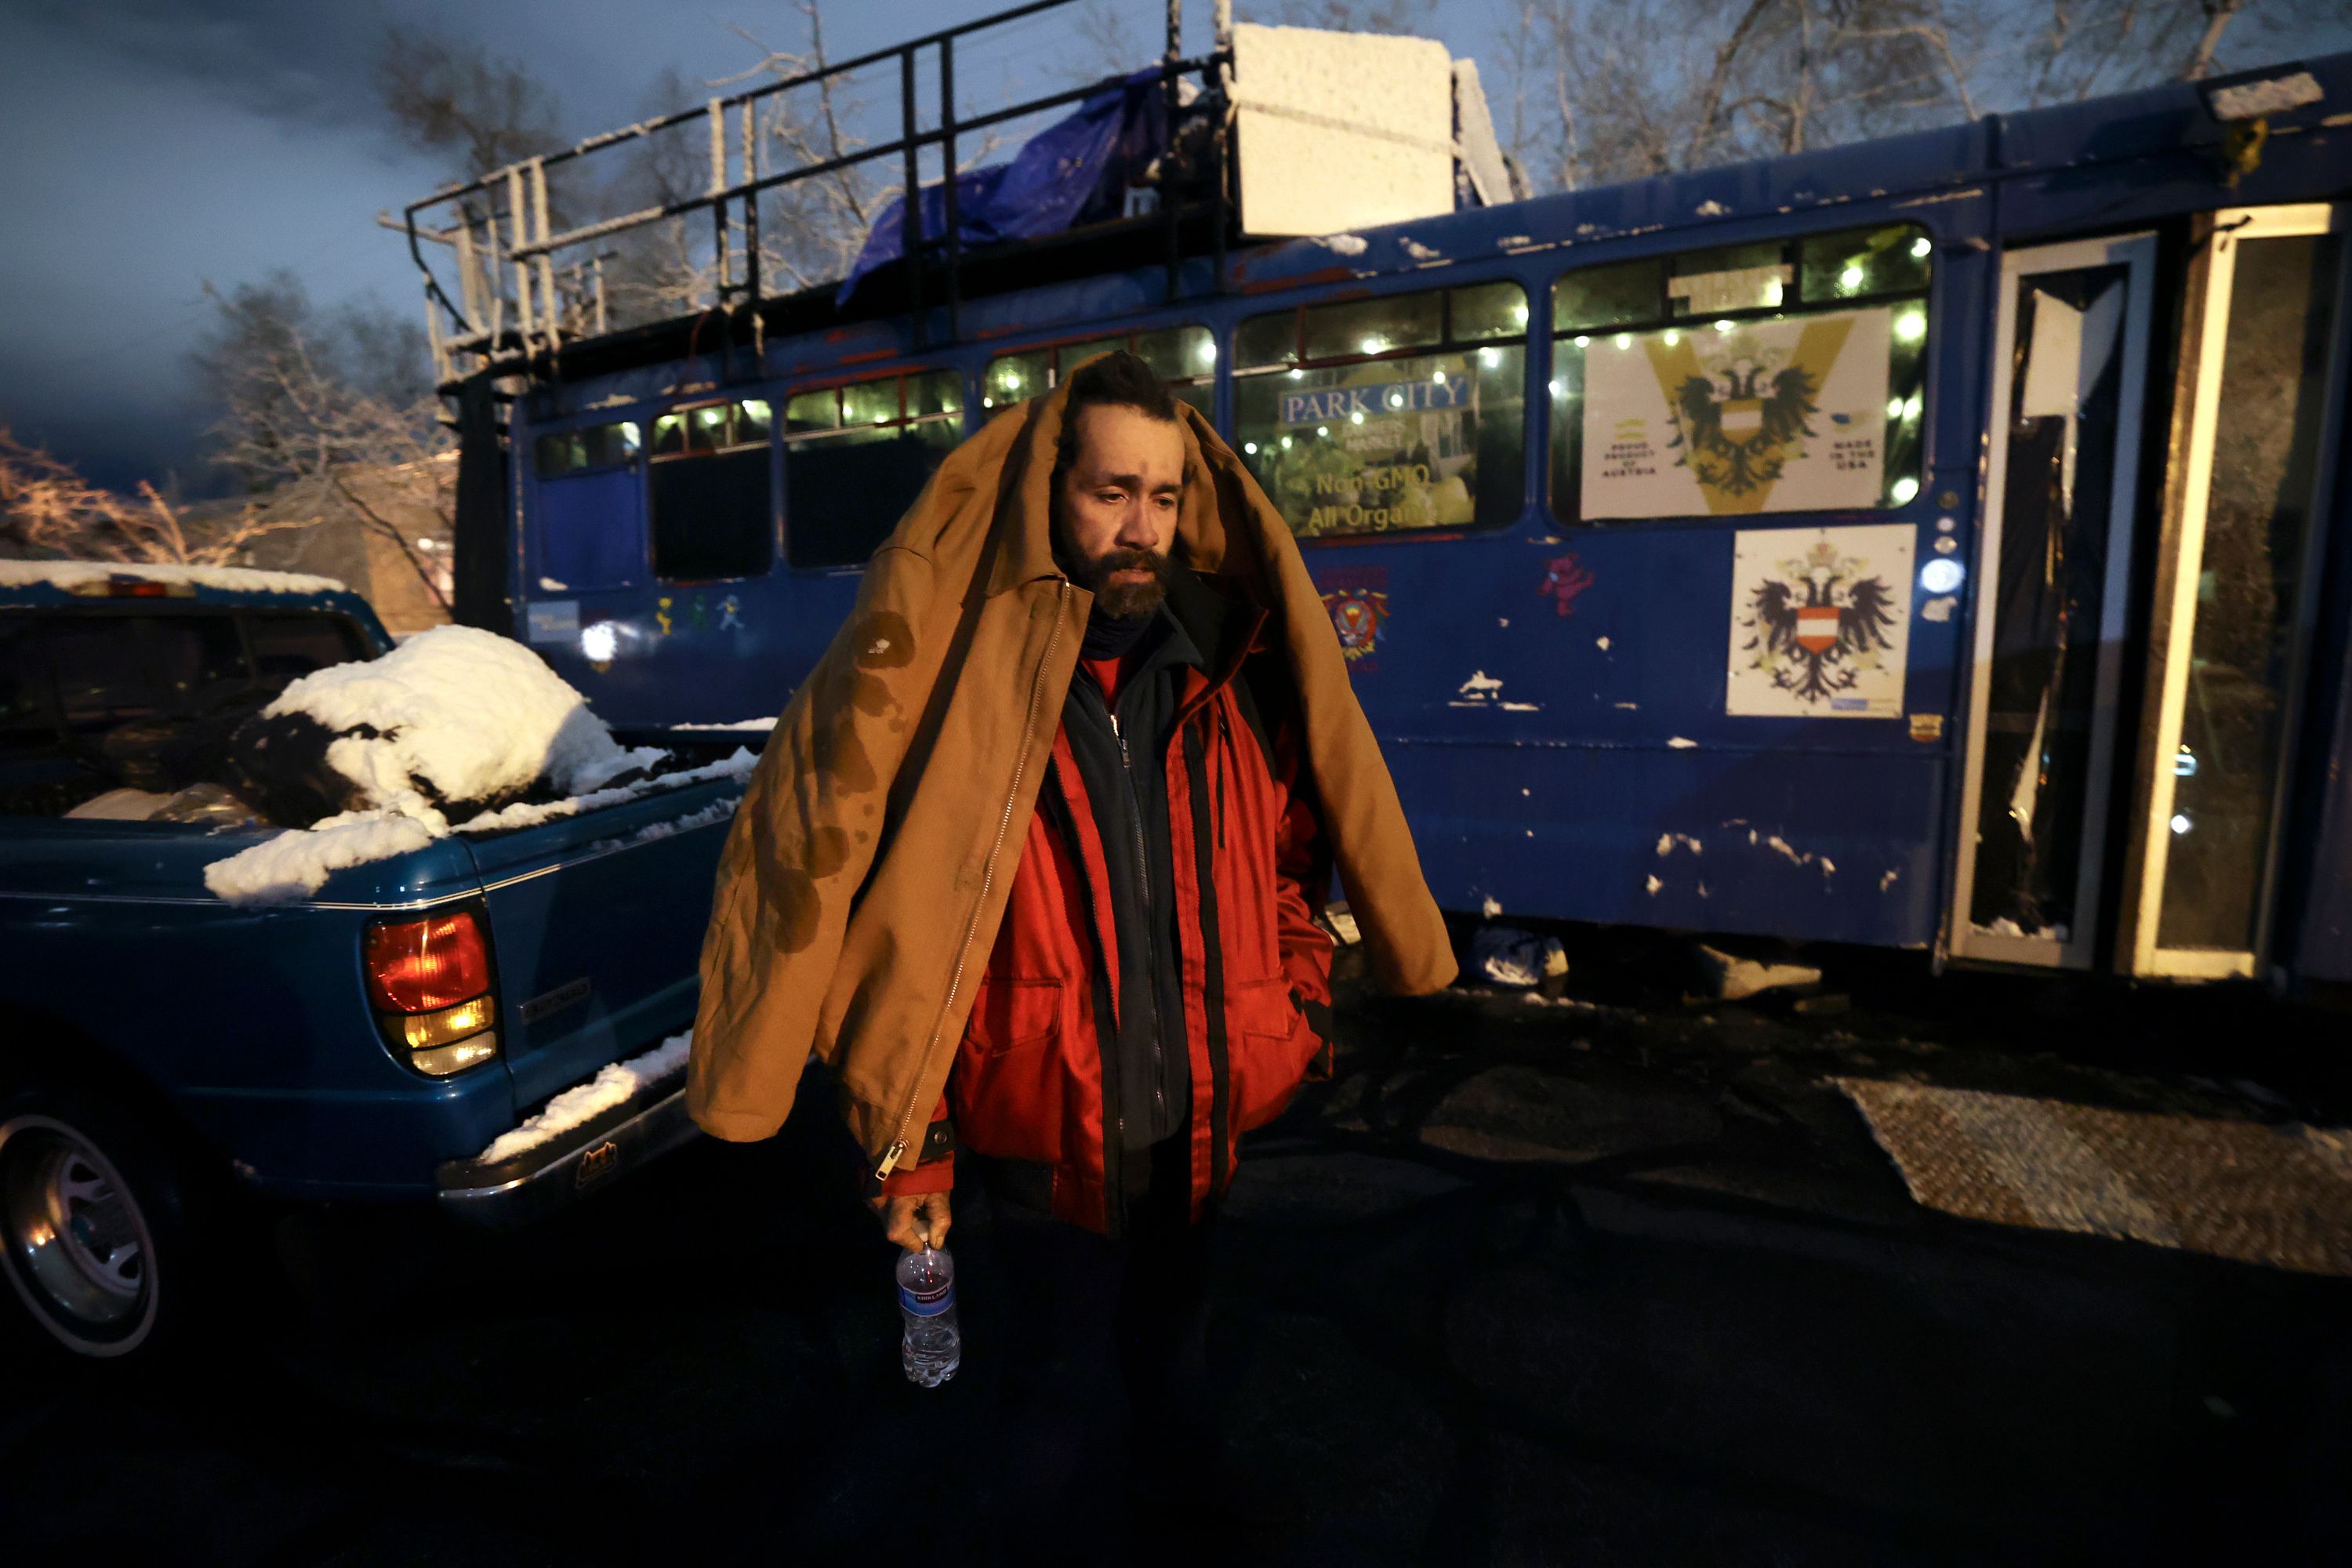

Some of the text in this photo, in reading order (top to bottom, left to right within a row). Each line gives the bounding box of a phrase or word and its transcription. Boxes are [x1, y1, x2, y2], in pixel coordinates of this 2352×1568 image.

[1287, 376, 1465, 422] PARK CITY
[1308, 506, 1339, 529] All
